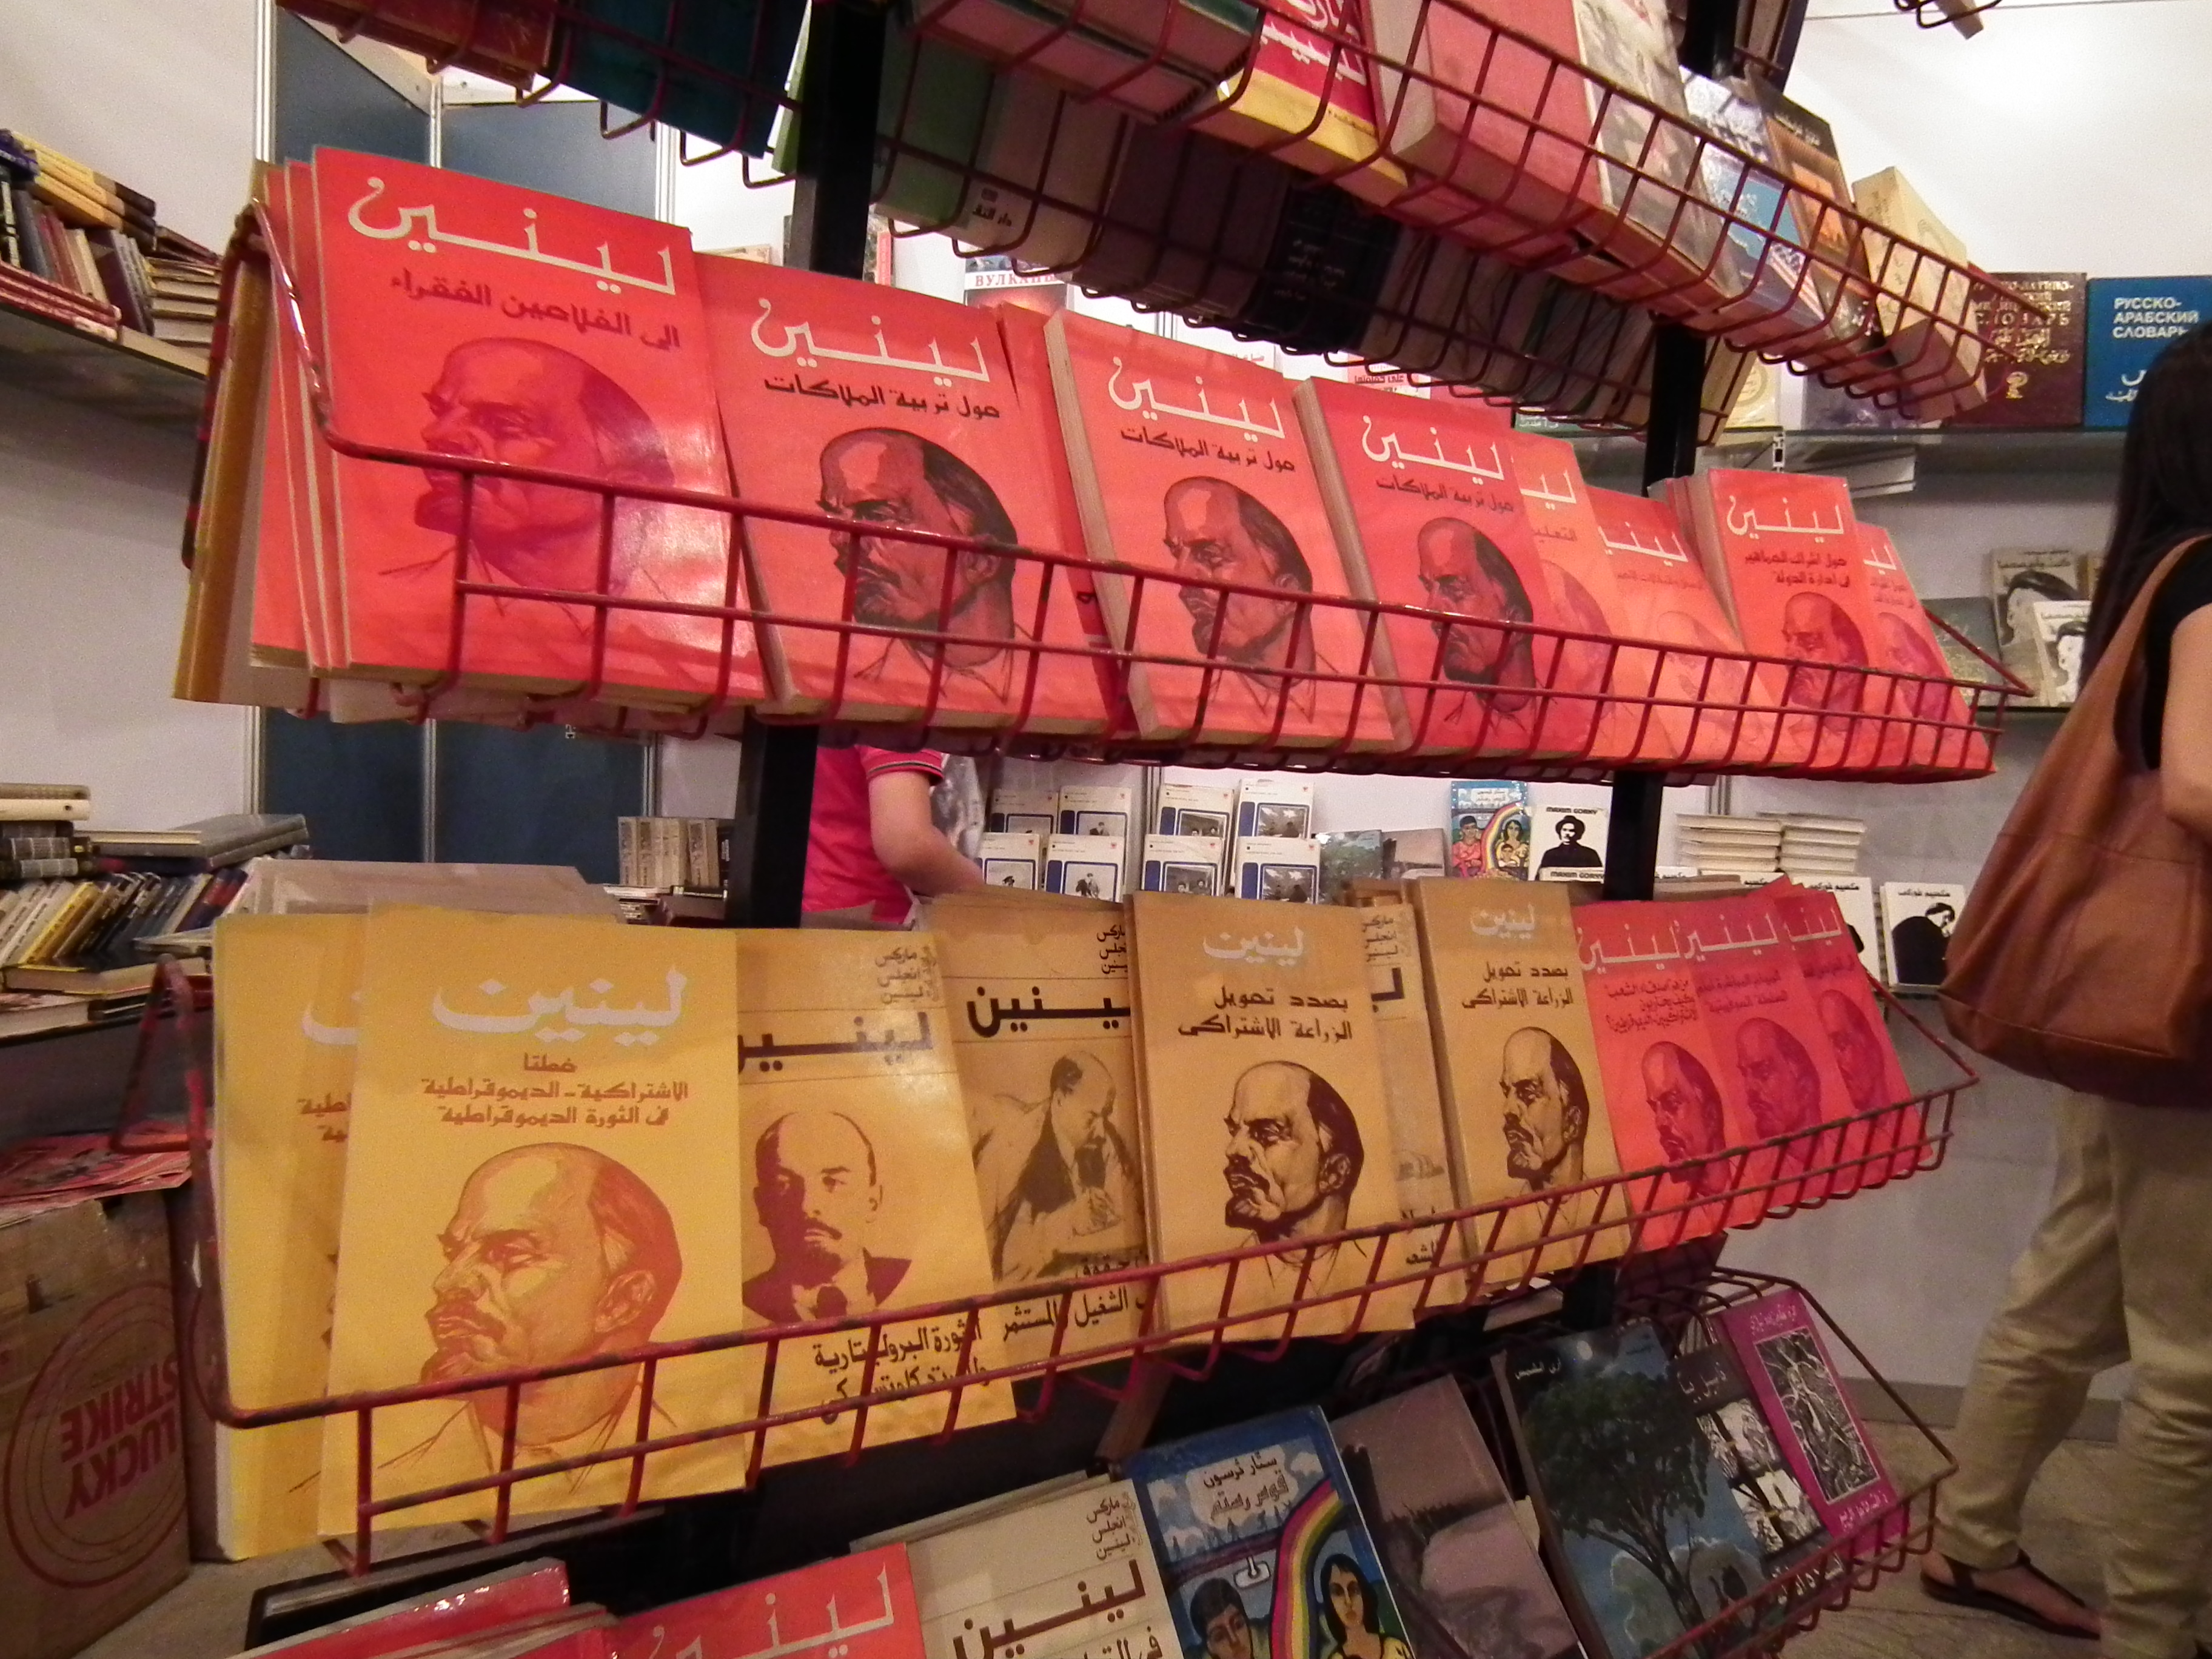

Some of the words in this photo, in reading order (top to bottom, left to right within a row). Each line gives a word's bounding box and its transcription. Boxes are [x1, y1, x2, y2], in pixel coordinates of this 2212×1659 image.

[349, 176, 675, 296] لينين
[391, 268, 492, 306] الفقراء
[501, 295, 631, 334] الفلاحين
[2113, 297, 2182, 310] РУССКО-
[2113, 309, 2200, 324] АРАБСКИЙ
[751, 298, 990, 387] لينين
[764, 374, 885, 407] الملاكات
[889, 388, 950, 415] تربية
[1108, 356, 1285, 442] لينين
[956, 395, 1000, 420] حول
[1121, 426, 1209, 458] الملاكات
[1213, 443, 1257, 467] تربية
[1362, 415, 1504, 485] لينين
[1264, 451, 1295, 472] حول
[1727, 495, 1844, 543] لينين
[1470, 903, 1535, 939] لينين
[1202, 925, 1305, 966] لينين
[1577, 920, 1681, 974] لينين
[1101, 960, 1128, 974] ينين
[431, 964, 688, 1047] لينين
[881, 985, 923, 1005] لينين
[1214, 985, 1275, 1010] تحويل
[1290, 995, 1348, 1013] بصدد
[967, 986, 1131, 1038] ينين
[1290, 1017, 1353, 1044] الزراعة
[437, 1103, 577, 1128] الديموقراطية
[586, 1105, 640, 1129] الثورة
[1074, 1284, 1129, 1327] الشغيل
[61, 1355, 180, 1463] STRIKE
[65, 1407, 178, 1518] LUCKY
[1086, 1496, 1120, 1524] ماركس
[1096, 1533, 1131, 1561] لينين
